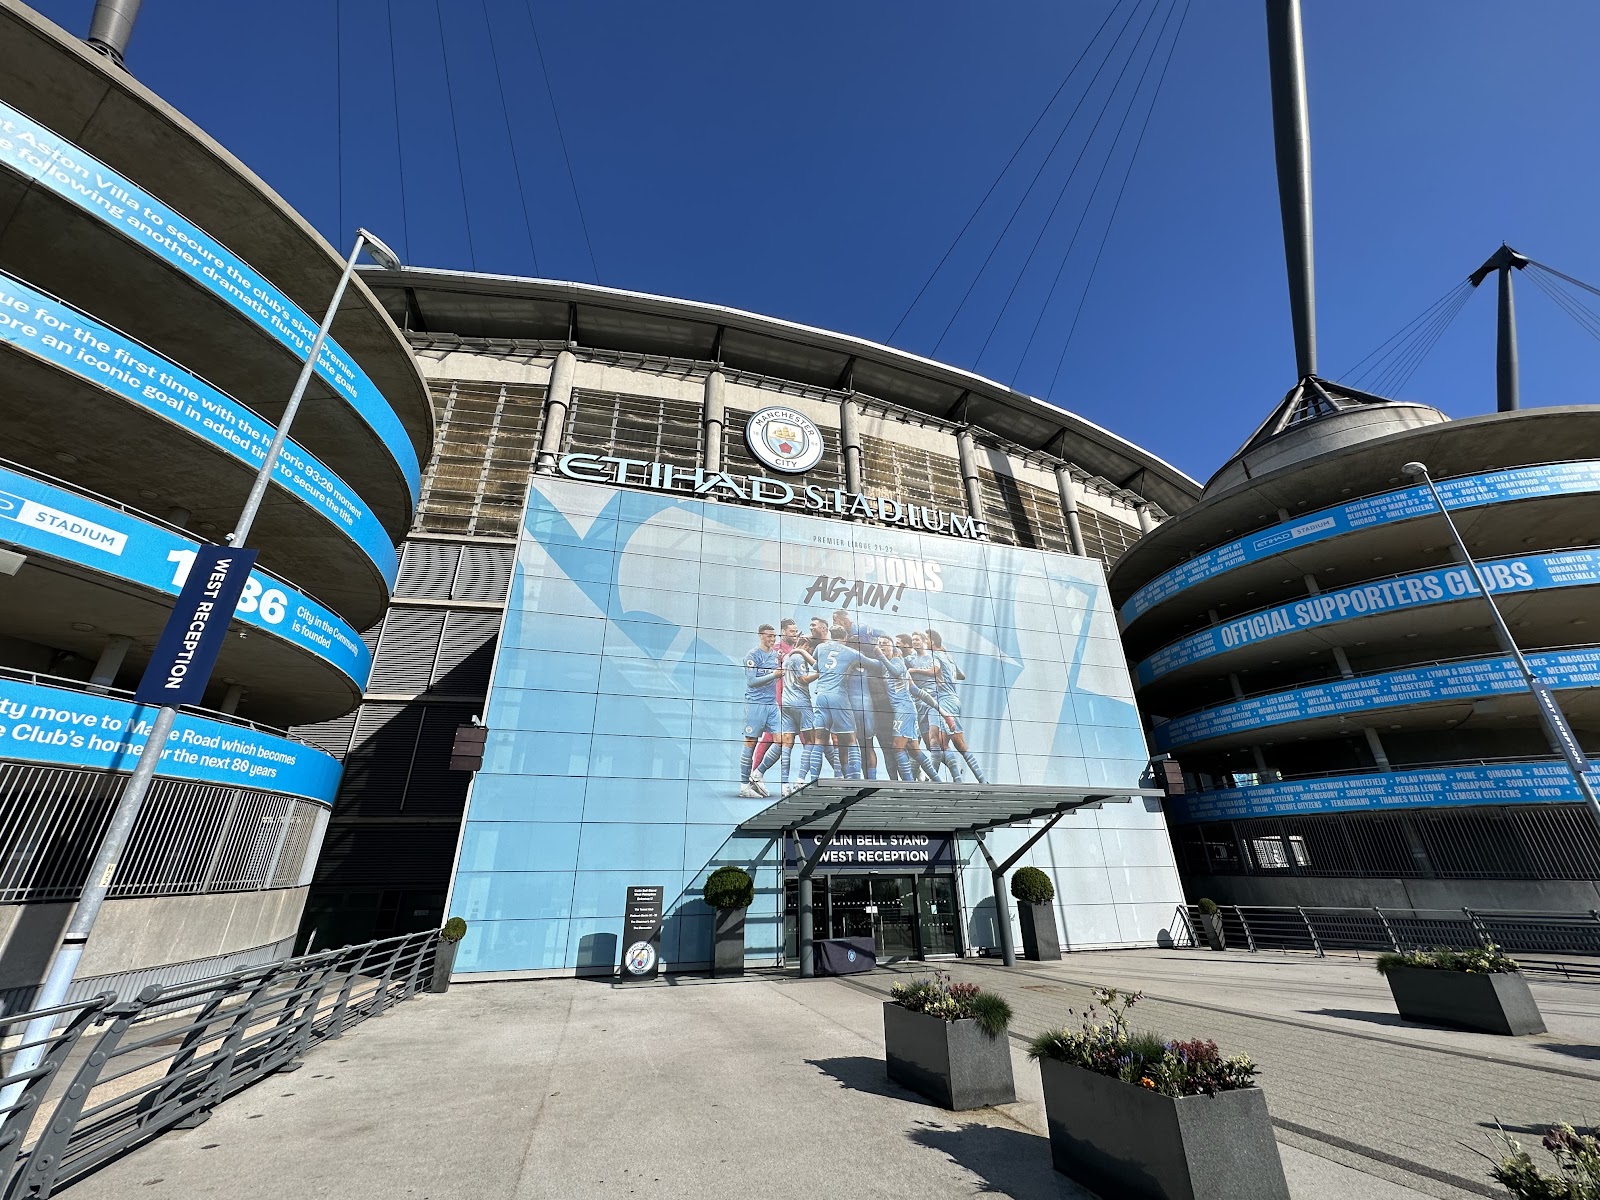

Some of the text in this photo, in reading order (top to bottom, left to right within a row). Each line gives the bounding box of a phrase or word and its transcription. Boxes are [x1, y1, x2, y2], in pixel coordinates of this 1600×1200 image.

[16, 132, 90, 178] Aston
[94, 174, 139, 211] Villa
[144, 207, 163, 225] to
[166, 224, 225, 269] secure
[227, 264, 251, 288] the
[320, 342, 356, 380] Premier
[17, 148, 358, 398] following another dramatic flurry late goals
[34, 308, 71, 331] for
[72, 327, 110, 354] the
[114, 348, 157, 378] first
[159, 373, 198, 402] time
[202, 397, 236, 424] with
[238, 419, 260, 440] the
[262, 434, 304, 470] hitoric
[333, 489, 362, 519] moment
[756, 412, 815, 436] MANCHESTER
[42, 334, 73, 355] an
[77, 348, 141, 388] iconic
[142, 385, 184, 412] goal
[185, 405, 202, 421] in
[203, 418, 250, 450] added
[280, 465, 293, 477] to
[293, 475, 325, 503] secure
[326, 497, 339, 513] the
[339, 509, 353, 526] title
[775, 459, 797, 467] CITY
[558, 453, 989, 541] ETIHAD STADIUM
[1418, 486, 1443, 496] ASSM
[1444, 480, 1476, 492] CITYZENS
[1350, 516, 1376, 527] CHICAGO
[1386, 509, 1404, 518] CHILE
[1444, 496, 1476, 506] CHILTERN
[1477, 492, 1499, 502] BLUES
[1388, 501, 1407, 510] MARY
[35, 512, 116, 546] STADIUM
[813, 535, 845, 546] PREMIER
[875, 544, 894, 553] 21-22
[1257, 521, 1330, 547] ETIHAD STADIUM
[1543, 555, 1592, 565] FALLOWFIELD
[1548, 564, 1588, 573] GIBRALTAR
[167, 549, 288, 625] 186
[1552, 572, 1597, 582] GUATEMALA
[804, 574, 906, 613] AGAIN!
[1221, 561, 1534, 648] OFFICIAL SUPPORTERS CLUBS
[164, 558, 232, 690] WEST RECEPTION
[292, 620, 332, 649] is founded
[297, 606, 314, 625] City
[314, 616, 321, 626] in
[322, 618, 334, 633] the
[824, 651, 840, 670] 5
[1301, 689, 1324, 698] LONDON
[1360, 679, 1381, 688] BLUES
[1390, 673, 1417, 684] LUSAKA
[1427, 669, 1450, 679] LYMM
[1458, 664, 1492, 675] DISTRICT
[1336, 699, 1364, 710] CITYZENS
[1398, 690, 1431, 701] CITYZENS
[1441, 684, 1481, 695] MONTREAL
[1543, 677, 1559, 685] BAY
[1342, 688, 1380, 700] MELBOURNE
[1391, 680, 1435, 692] MERSEYSIDE
[1447, 675, 1475, 685] METRO
[1476, 671, 1506, 682] DETROIT
[1546, 666, 1578, 675] MEXICO
[1580, 663, 1598, 671] CITY
[30, 705, 296, 766] move to Road which becomes
[1540, 689, 1582, 764] WEST RECEPTION
[88, 737, 143, 756] home
[173, 748, 198, 765] the
[200, 754, 230, 770] next
[250, 762, 277, 778] years
[1310, 781, 1344, 792] PRESTWICH
[1349, 778, 1387, 788] WHITEFIELD
[1395, 776, 1419, 784] PULAU
[1419, 773, 1447, 782] PINANG
[1456, 772, 1477, 780] PUNE
[1486, 768, 1522, 779] QINGDAO
[1533, 766, 1569, 776] RALEIGH
[1345, 787, 1386, 797] SHROPSHIRE
[1394, 785, 1420, 794] SIERRA
[1420, 784, 1443, 792] LEONE
[1452, 780, 1496, 790] SINGAPORE
[1506, 778, 1535, 788] SOUTH
[1535, 776, 1570, 786] FLORIDA
[1298, 800, 1322, 809] CITYZENS
[1379, 796, 1408, 804] THAMES
[1409, 794, 1434, 802] VALLEY
[1446, 791, 1482, 801] TLEMCEN
[1483, 789, 1521, 799] CITYZENS
[1533, 788, 1562, 796] TOKYO
[814, 834, 929, 846] CLIN BELL STAND
[819, 850, 929, 862] WEST RECEPTION
